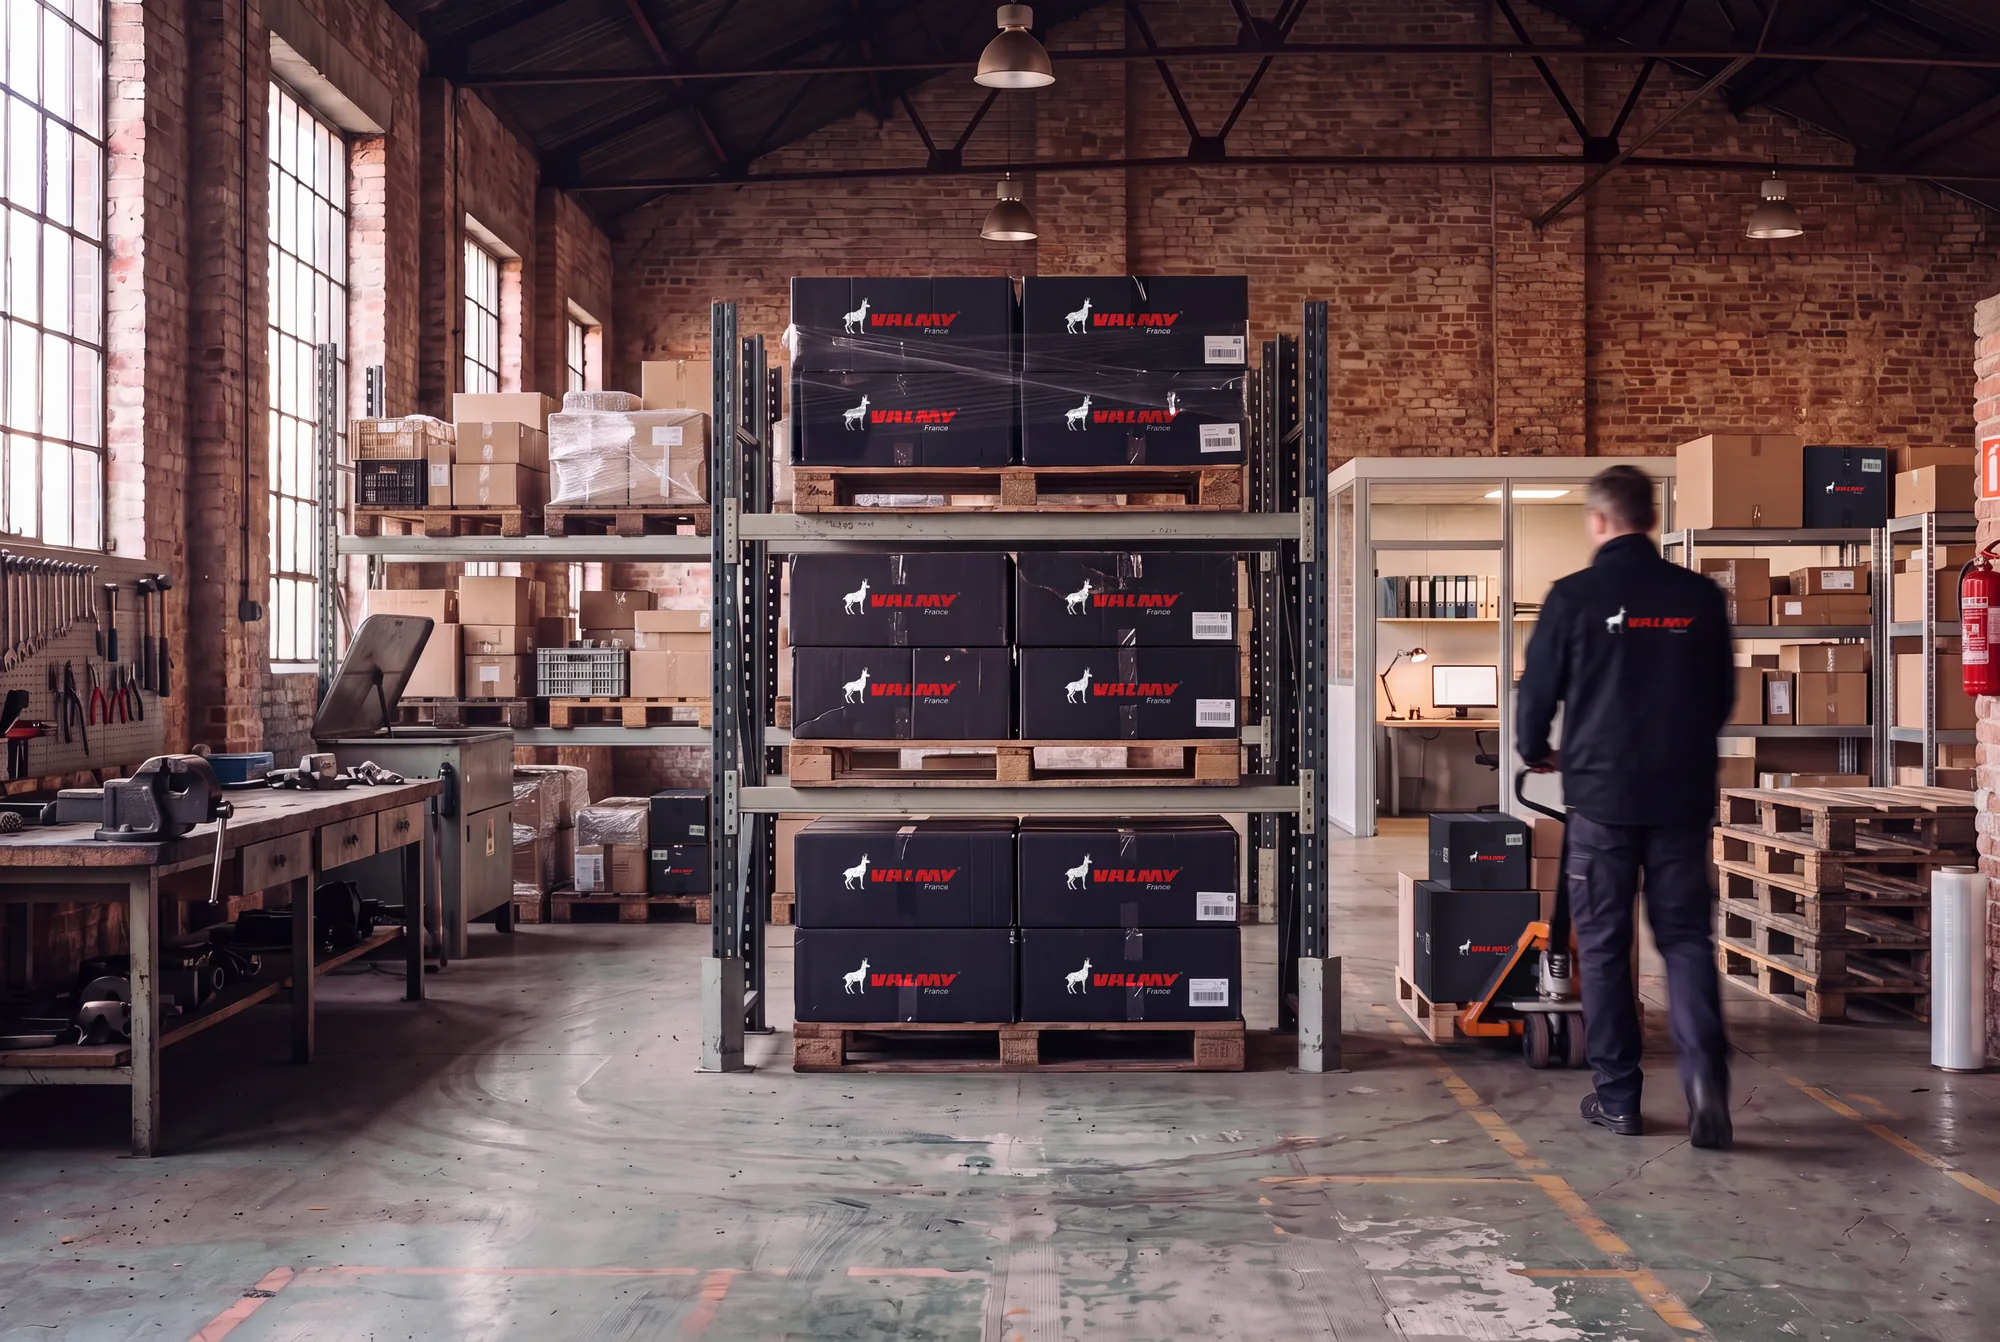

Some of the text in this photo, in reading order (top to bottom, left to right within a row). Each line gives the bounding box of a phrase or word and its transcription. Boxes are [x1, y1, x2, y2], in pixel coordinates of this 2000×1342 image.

[871, 313, 957, 327] VALMY
[1093, 313, 1180, 327] VALMY
[923, 327, 949, 335] France
[1146, 327, 1171, 335] France
[871, 409, 957, 424] VALMY
[1093, 409, 1180, 424] VALMY
[923, 424, 949, 432] France
[1146, 424, 1171, 432] France
[871, 593, 957, 608] VALMY
[1093, 593, 1180, 608] VALMY
[923, 608, 949, 616] France
[1146, 608, 1171, 616] France
[1627, 617, 1695, 628] VALMY
[871, 682, 957, 697] VALMY
[1093, 682, 1180, 697] VALMY
[923, 697, 949, 705] France
[1146, 697, 1171, 705] France
[871, 868, 957, 883] VALMY
[1093, 868, 1180, 883] VALMY
[923, 883, 949, 891] France
[1146, 883, 1171, 891] France
[1471, 945, 1511, 953] VALMY
[871, 973, 957, 987] VALMY
[1093, 973, 1180, 987] VALMY
[923, 987, 949, 996] France
[1146, 987, 1171, 996] France
